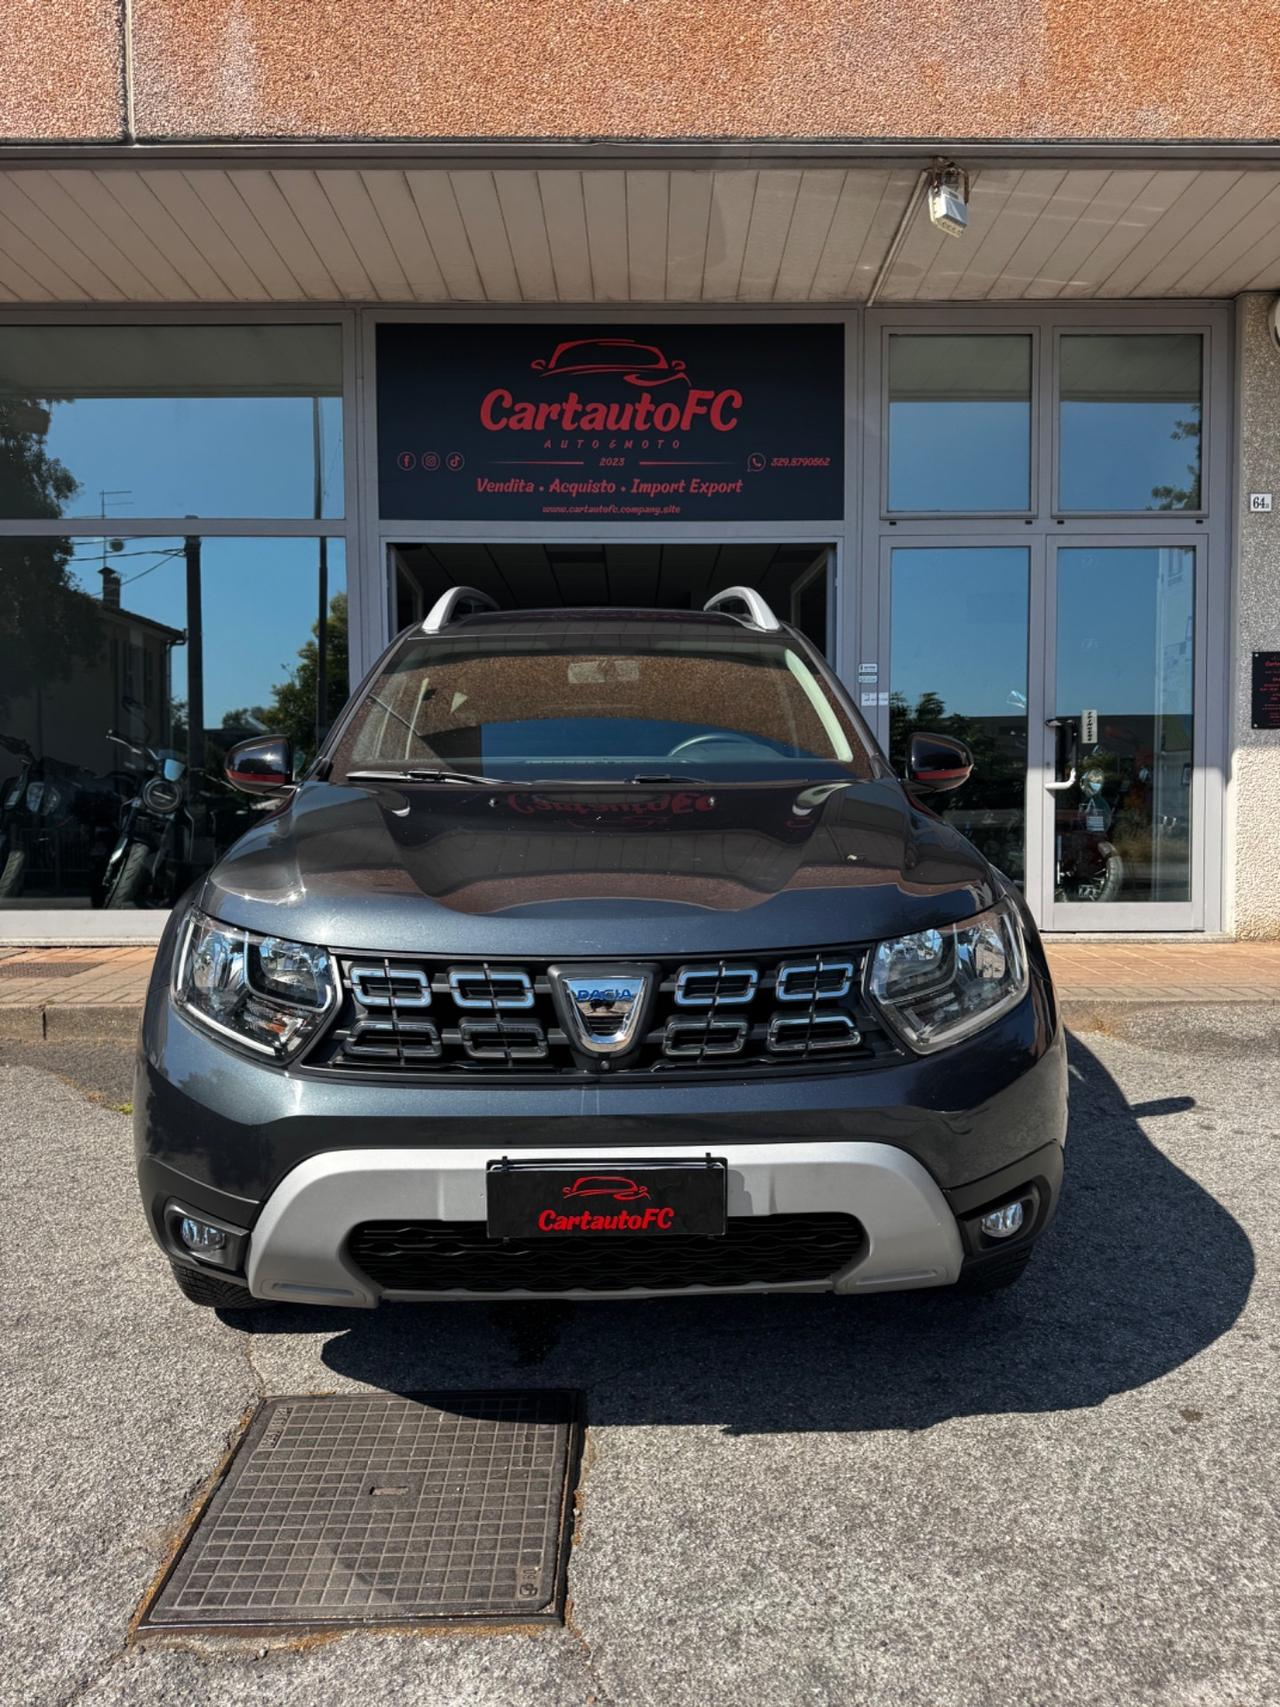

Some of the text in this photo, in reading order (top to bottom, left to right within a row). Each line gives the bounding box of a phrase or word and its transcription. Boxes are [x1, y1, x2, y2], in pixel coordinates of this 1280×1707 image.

[479, 388, 743, 433] CartautoFC
[600, 456, 625, 467] 2023
[476, 478, 743, 497] Vendita Acquisto Import Export
[577, 989, 632, 1000] DACIA
[537, 1206, 676, 1232] CartautoFC
